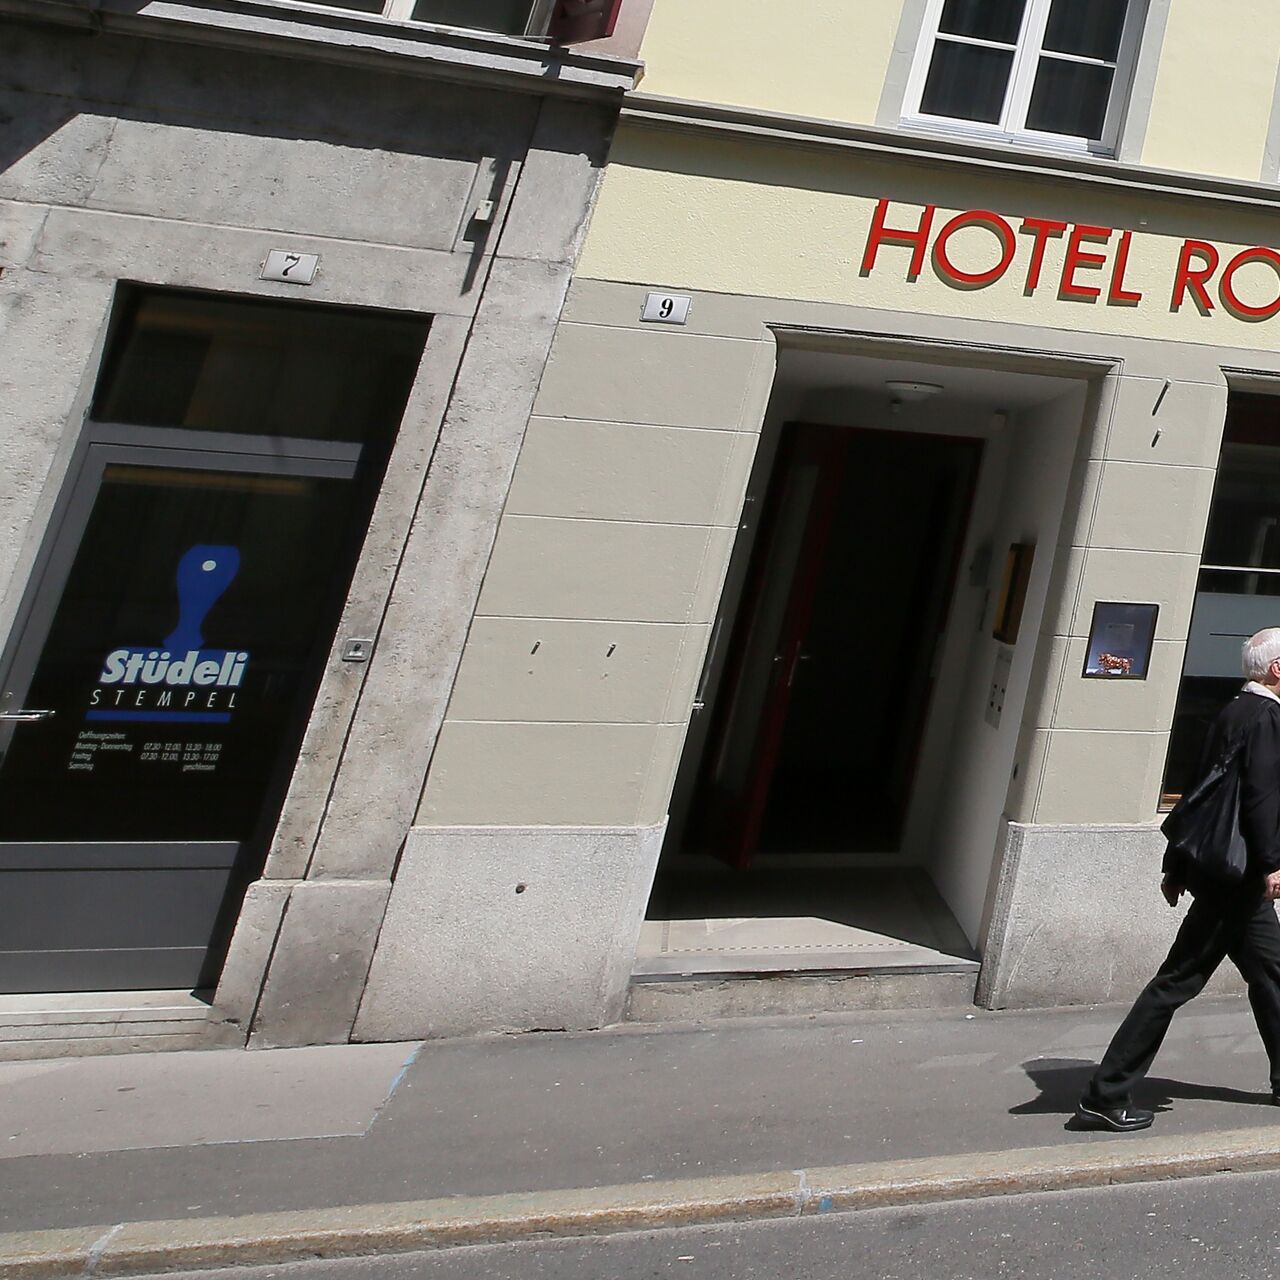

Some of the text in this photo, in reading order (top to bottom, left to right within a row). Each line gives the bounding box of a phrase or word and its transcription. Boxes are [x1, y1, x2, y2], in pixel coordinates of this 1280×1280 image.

[861, 198, 1141, 306] HOTEL
[282, 255, 300, 277] 7
[659, 298, 674, 319] 9
[100, 650, 248, 686] Stüdeli
[90, 689, 237, 708] STEMPEL
